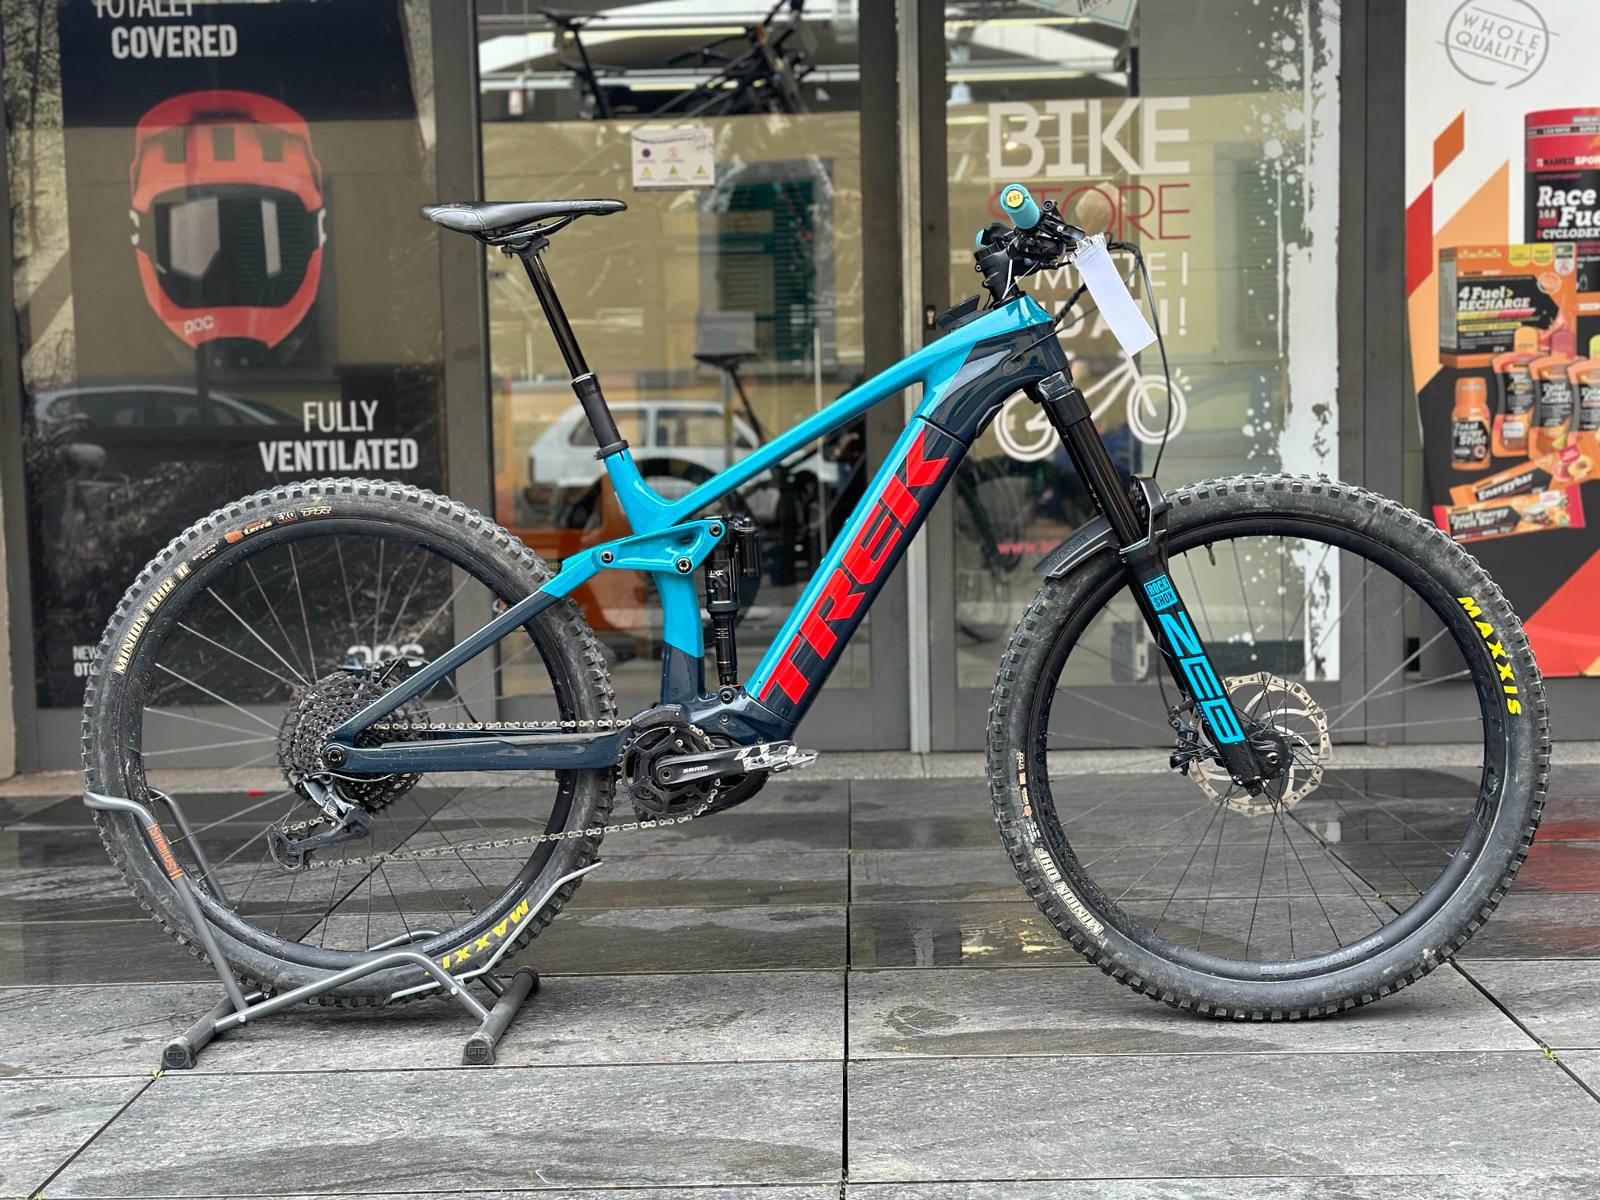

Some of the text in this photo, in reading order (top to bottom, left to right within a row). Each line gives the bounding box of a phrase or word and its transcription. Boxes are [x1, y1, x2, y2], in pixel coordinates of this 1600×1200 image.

[111, 24, 238, 60] COVERED
[1455, 30, 1536, 67] QUALITY
[1462, 12, 1542, 50] WHOLE
[987, 97, 1191, 178] BIKE
[1536, 185, 1597, 208] Race
[1458, 297, 1531, 311] RECHARGE
[303, 400, 379, 433] FULLY
[259, 438, 419, 473] VENTILATED
[759, 428, 949, 704] TREK
[1147, 576, 1170, 595] ROCK
[1153, 591, 1176, 609] SHOX
[113, 613, 151, 676] MINION
[1457, 596, 1522, 716] MAXXIS
[1158, 610, 1247, 744] ZEB
[1054, 881, 1105, 937] MINION
[424, 898, 529, 977] MAXXI
